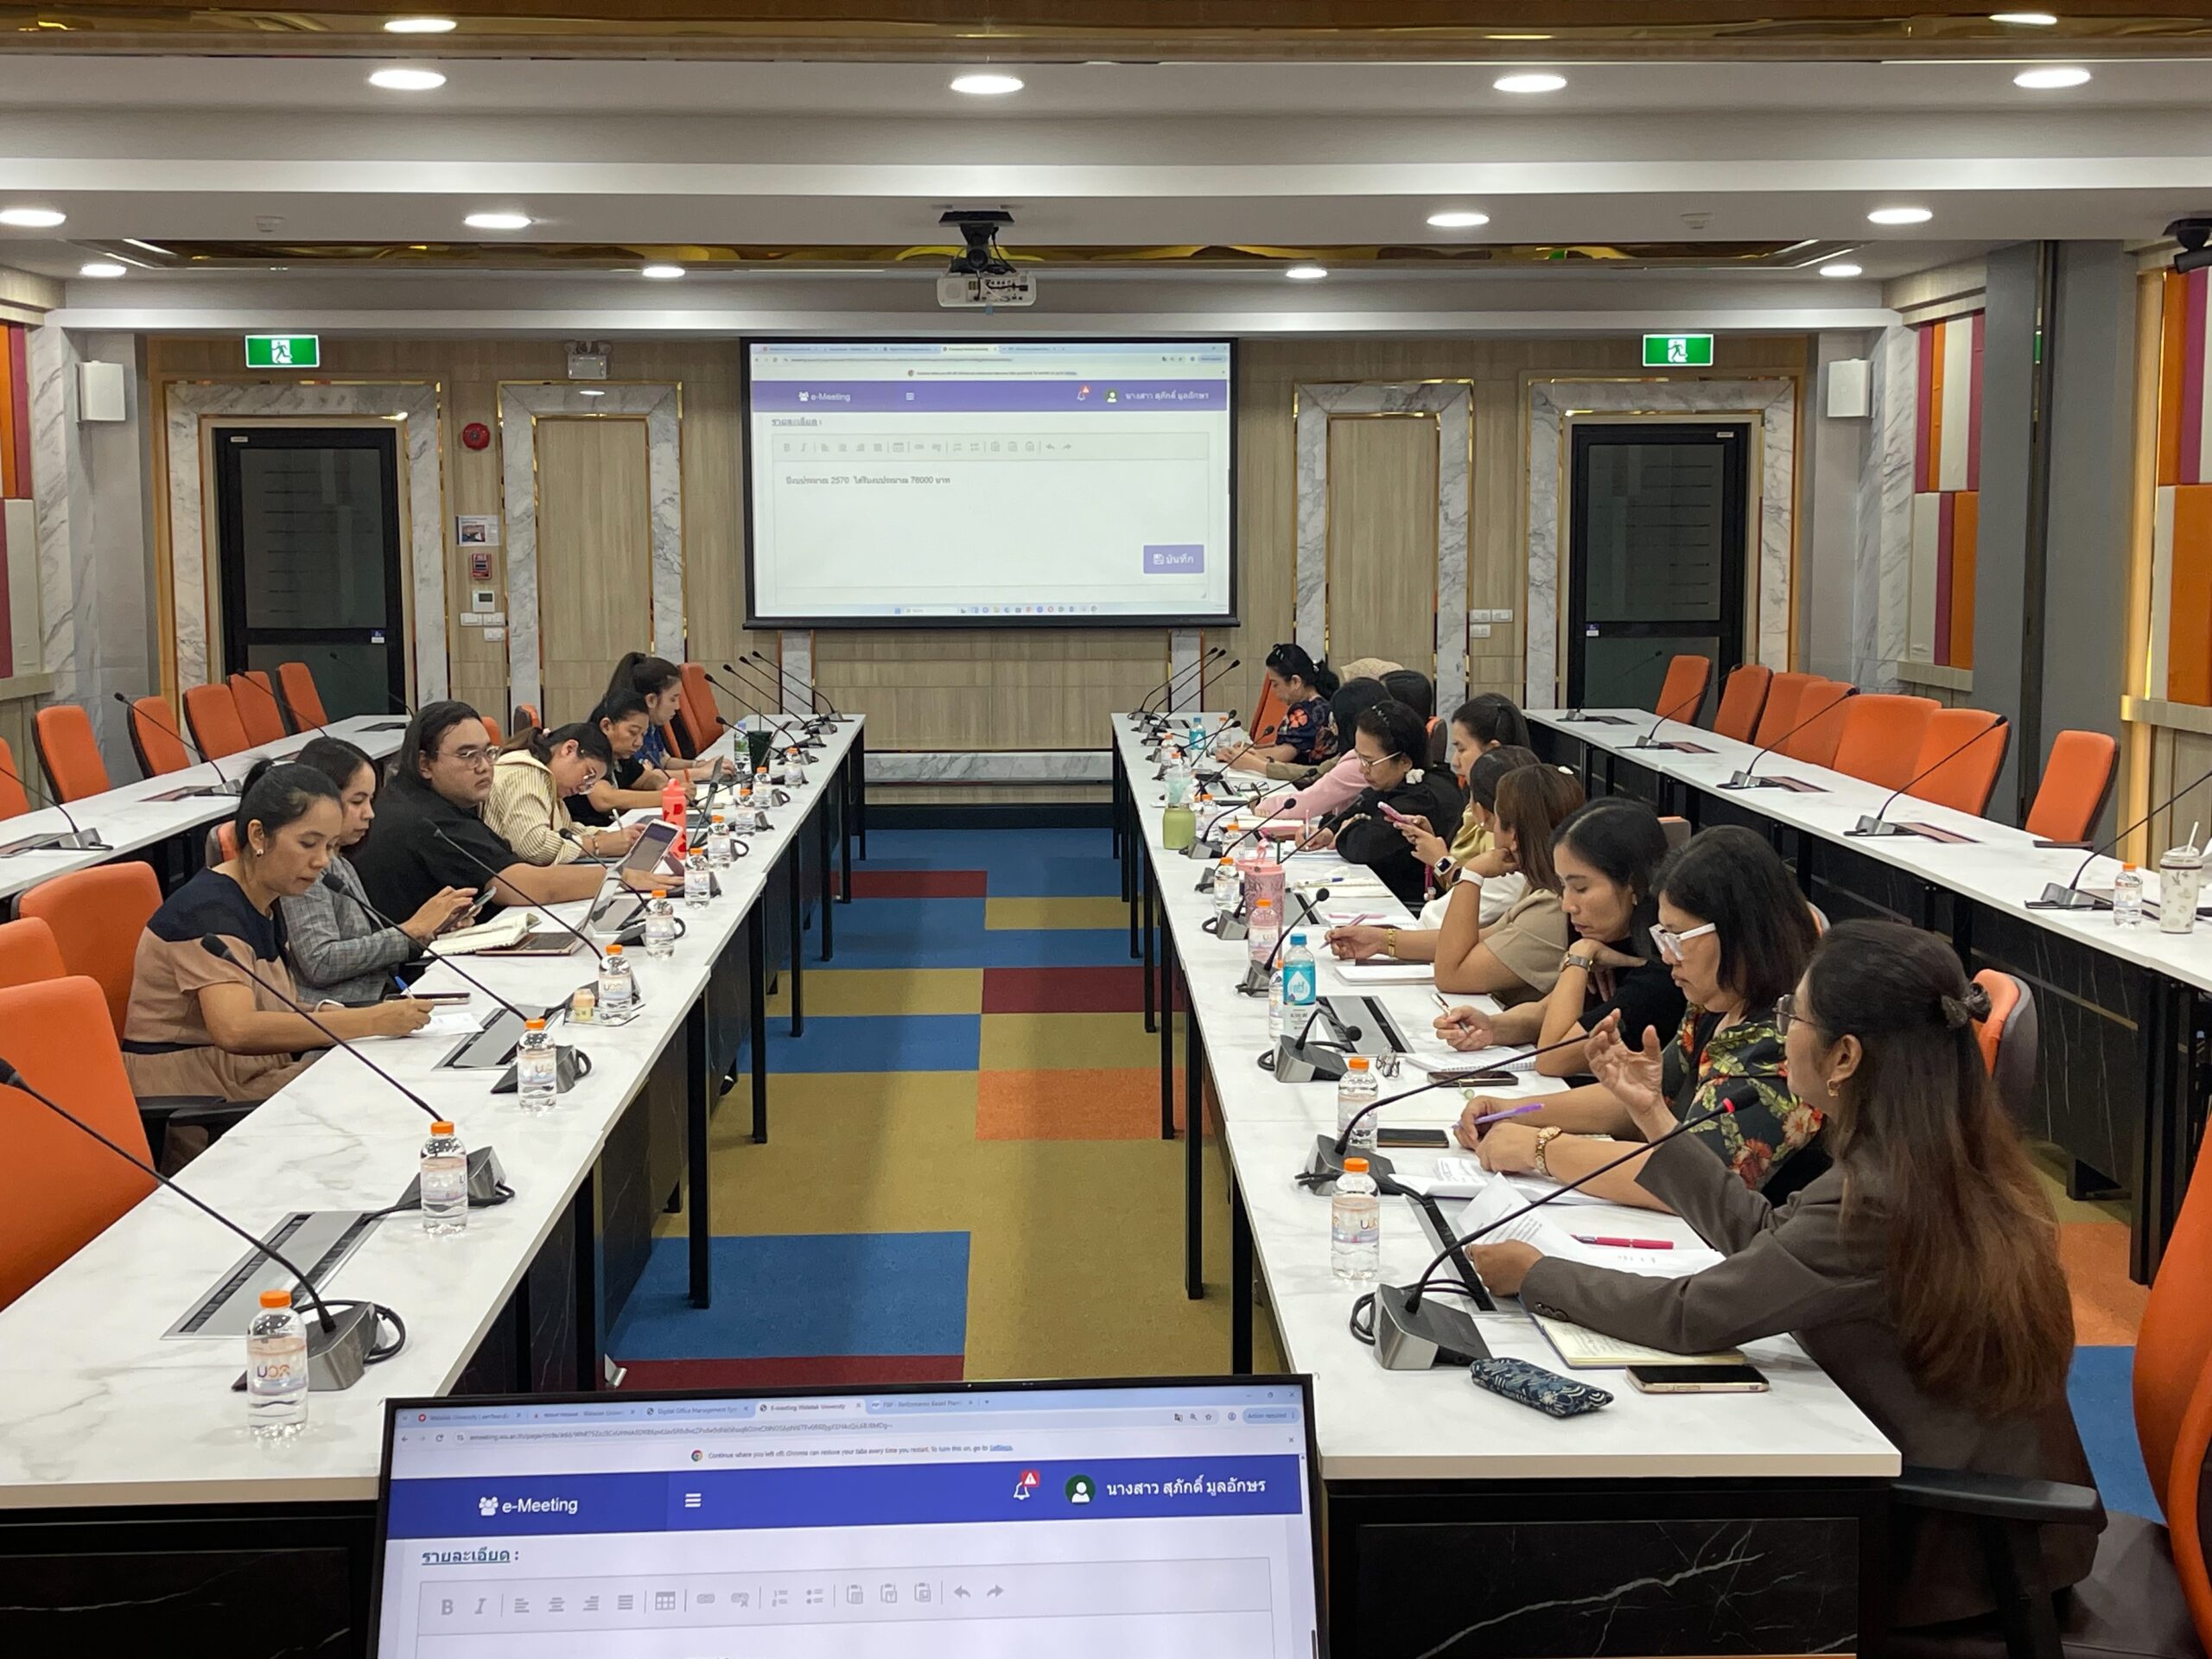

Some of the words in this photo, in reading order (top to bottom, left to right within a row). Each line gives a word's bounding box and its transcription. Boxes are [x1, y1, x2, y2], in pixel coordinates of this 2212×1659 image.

[830, 476, 849, 485] 2570
[1106, 1483, 1160, 1496] นางสาว
[1206, 1477, 1267, 1497] มูลอักษร
[502, 1497, 578, 1515] e-Meeting
[422, 1547, 511, 1565] รายละเอียด
